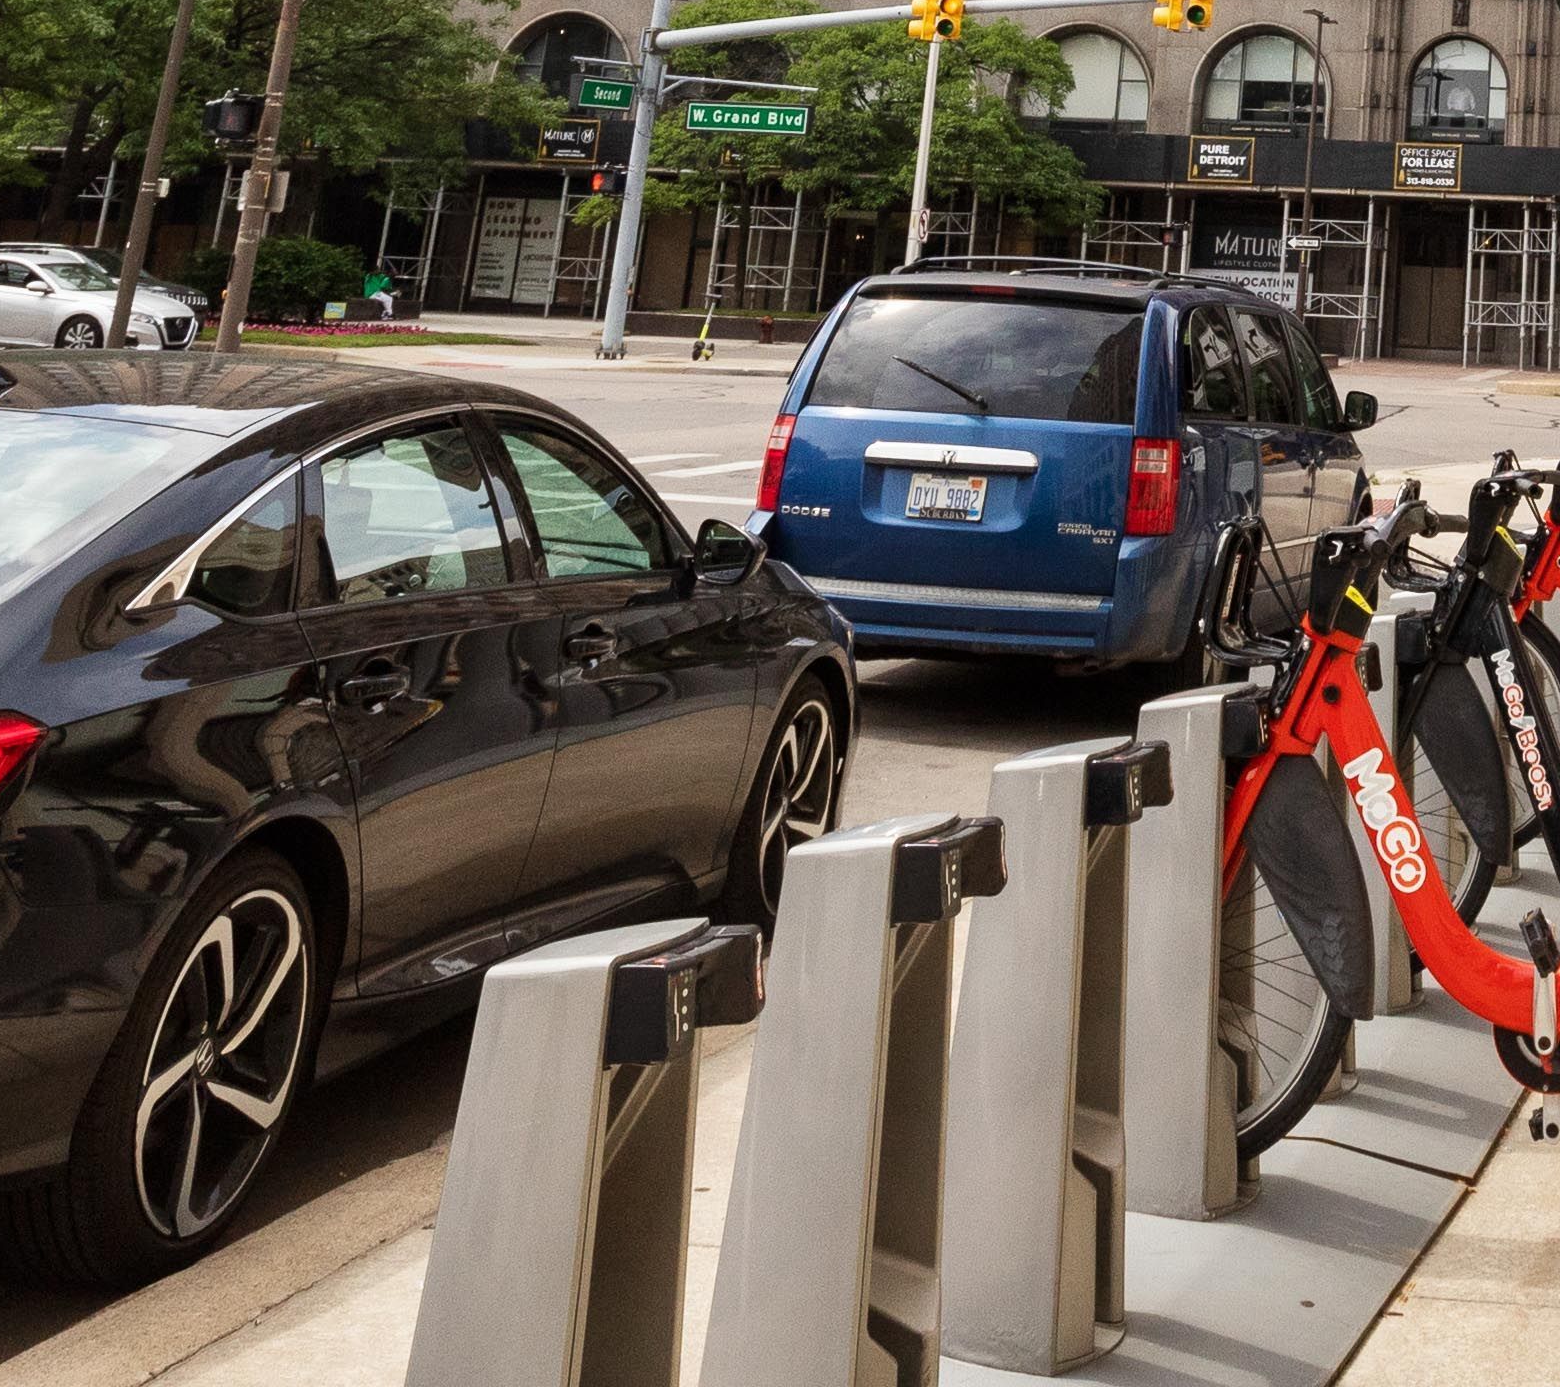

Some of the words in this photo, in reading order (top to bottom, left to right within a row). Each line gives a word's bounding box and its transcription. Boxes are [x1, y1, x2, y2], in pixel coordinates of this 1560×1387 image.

[593, 86, 621, 102] Second
[693, 108, 708, 123] W.
[712, 109, 760, 125] Grand
[767, 111, 803, 127] Blvd
[1200, 144, 1230, 155] PURE
[1400, 147, 1429, 157] OFFICE
[1431, 149, 1457, 158] SPACE
[1200, 155, 1247, 166] DETROIT
[1401, 157, 1423, 167] FOR
[1424, 158, 1456, 168] LEASE
[913, 486, 939, 507] DYU
[946, 488, 980, 509] 9882
[781, 505, 831, 517] DODGE
[1058, 528, 1116, 537] CARAVAN
